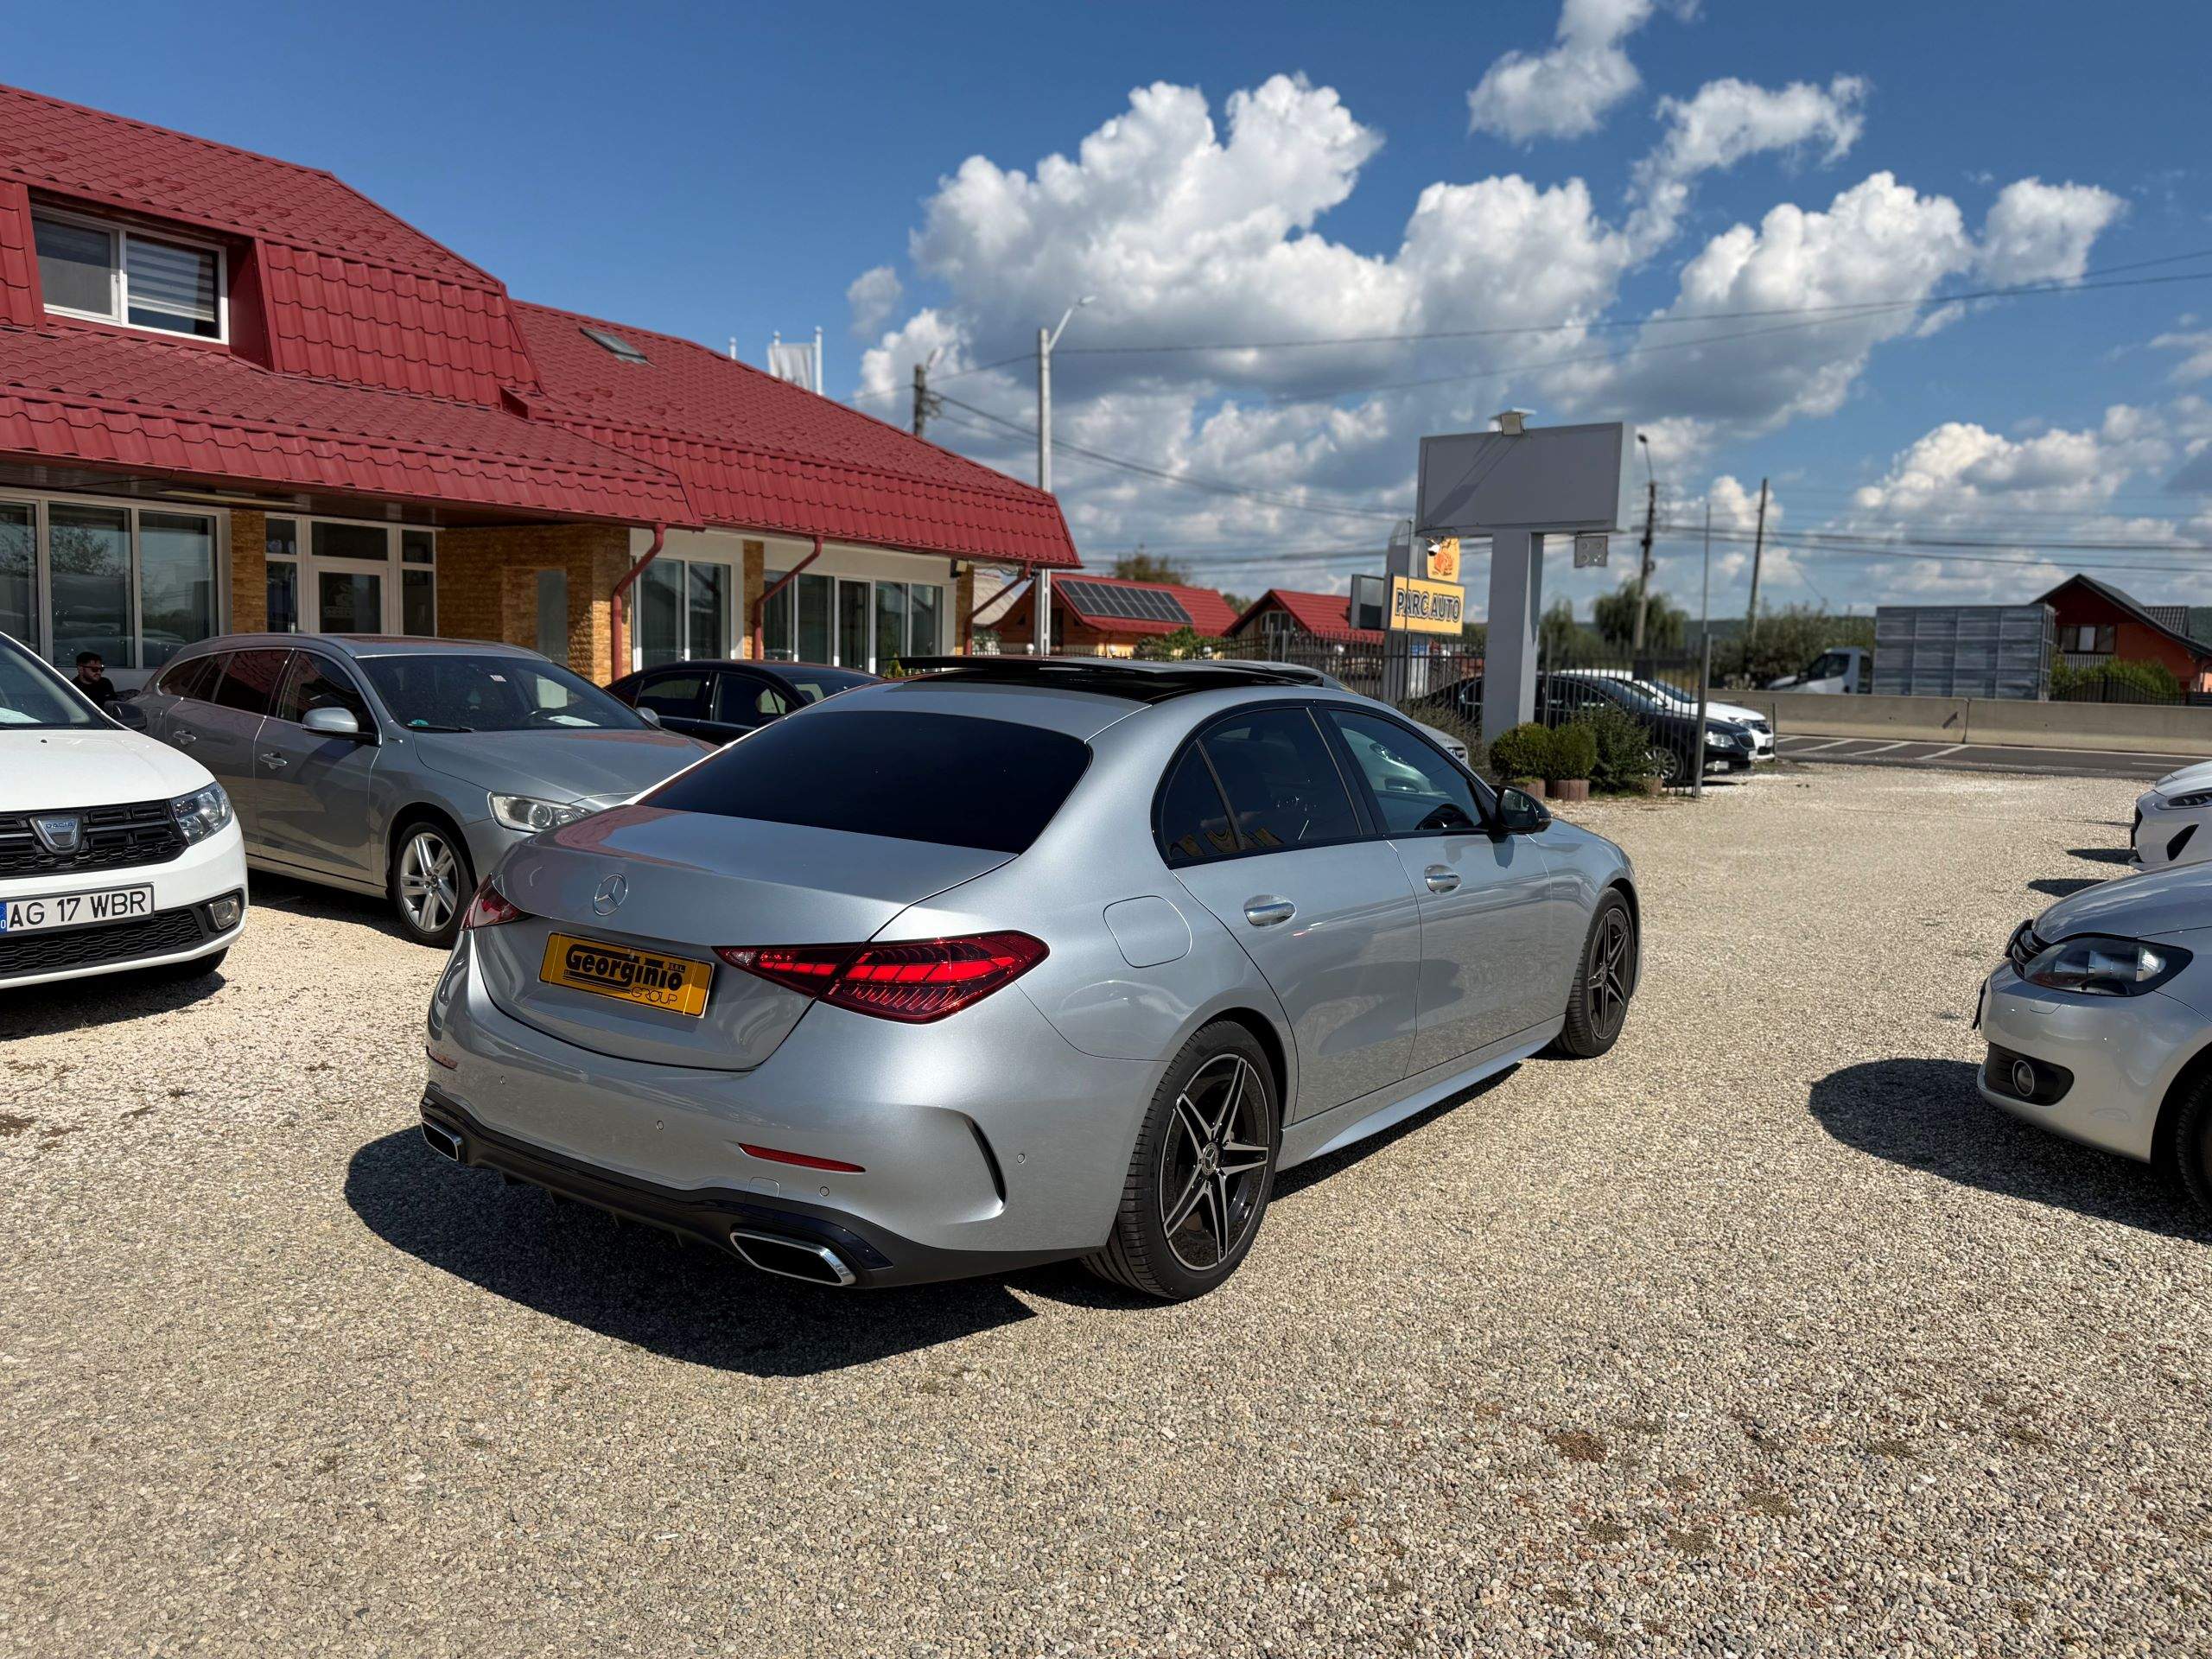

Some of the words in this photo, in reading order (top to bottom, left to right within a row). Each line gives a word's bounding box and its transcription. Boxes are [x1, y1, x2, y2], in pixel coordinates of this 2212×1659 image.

[1395, 588, 1429, 619] PARC
[1430, 593, 1462, 623] AUTO
[9, 901, 45, 928] AG
[57, 897, 81, 922] 17
[90, 890, 146, 918] WBR
[566, 944, 683, 991] Georginio
[632, 986, 677, 1004] GROUP
